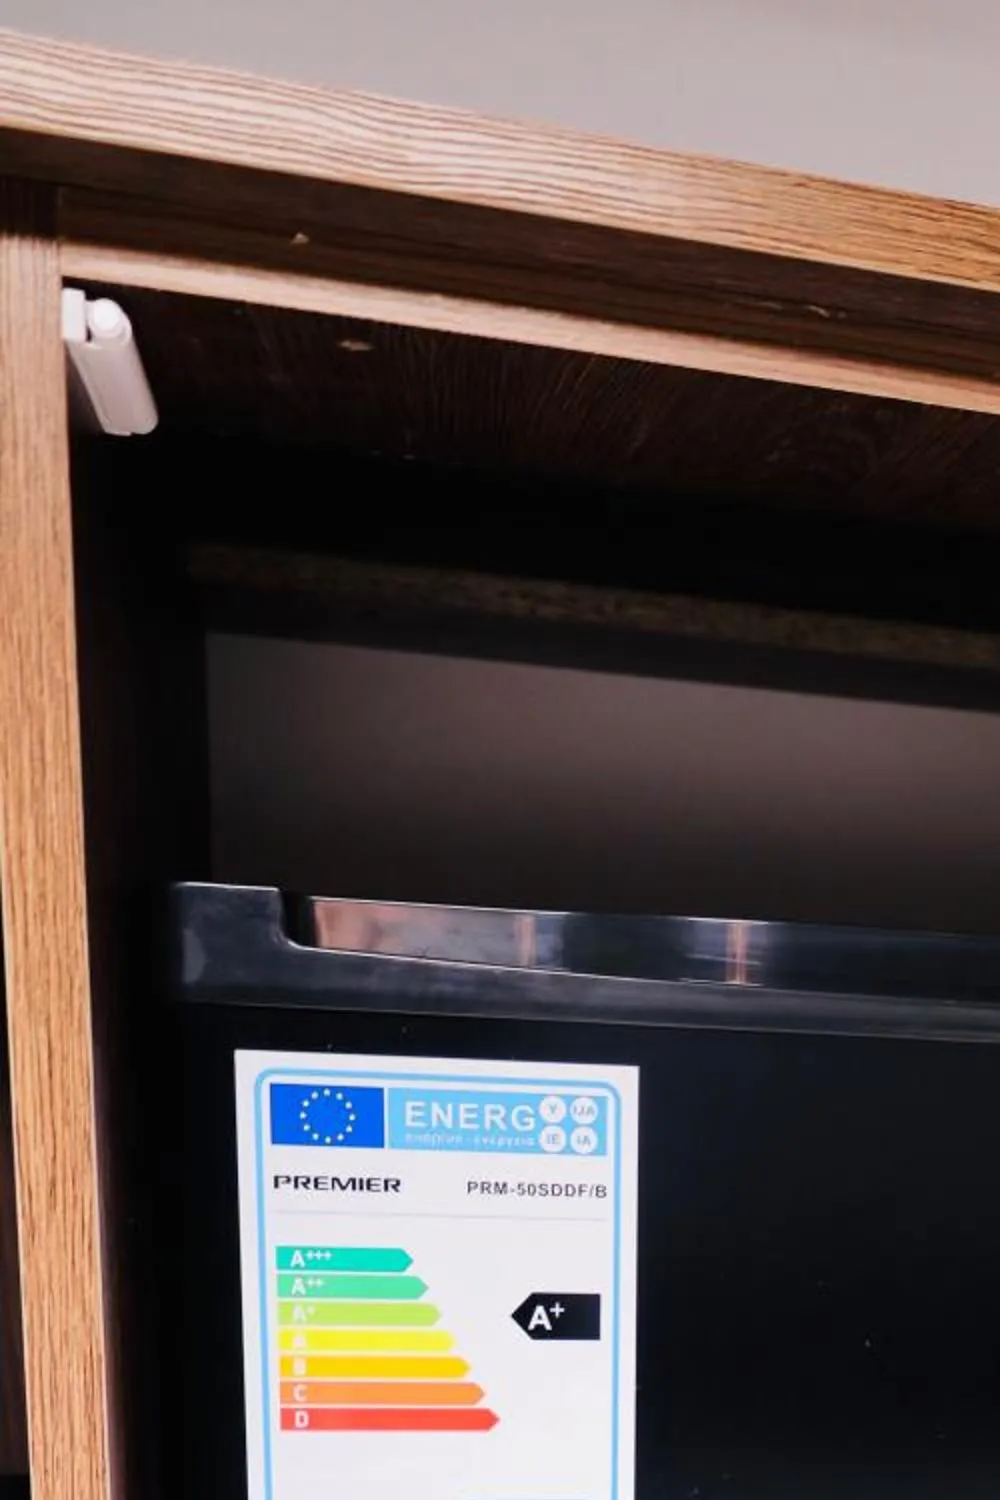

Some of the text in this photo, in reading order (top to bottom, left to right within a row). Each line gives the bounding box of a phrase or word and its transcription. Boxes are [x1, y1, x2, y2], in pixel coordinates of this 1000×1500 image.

[404, 1101, 537, 1131] ENERG
[272, 1174, 401, 1194] PREMIER
[467, 1180, 608, 1199] PRM-50SDDF/B
[290, 1249, 332, 1268] A+++
[291, 1277, 324, 1295] A++
[527, 1302, 565, 1331] A+
[294, 1384, 307, 1402] C
[295, 1409, 309, 1429] D
